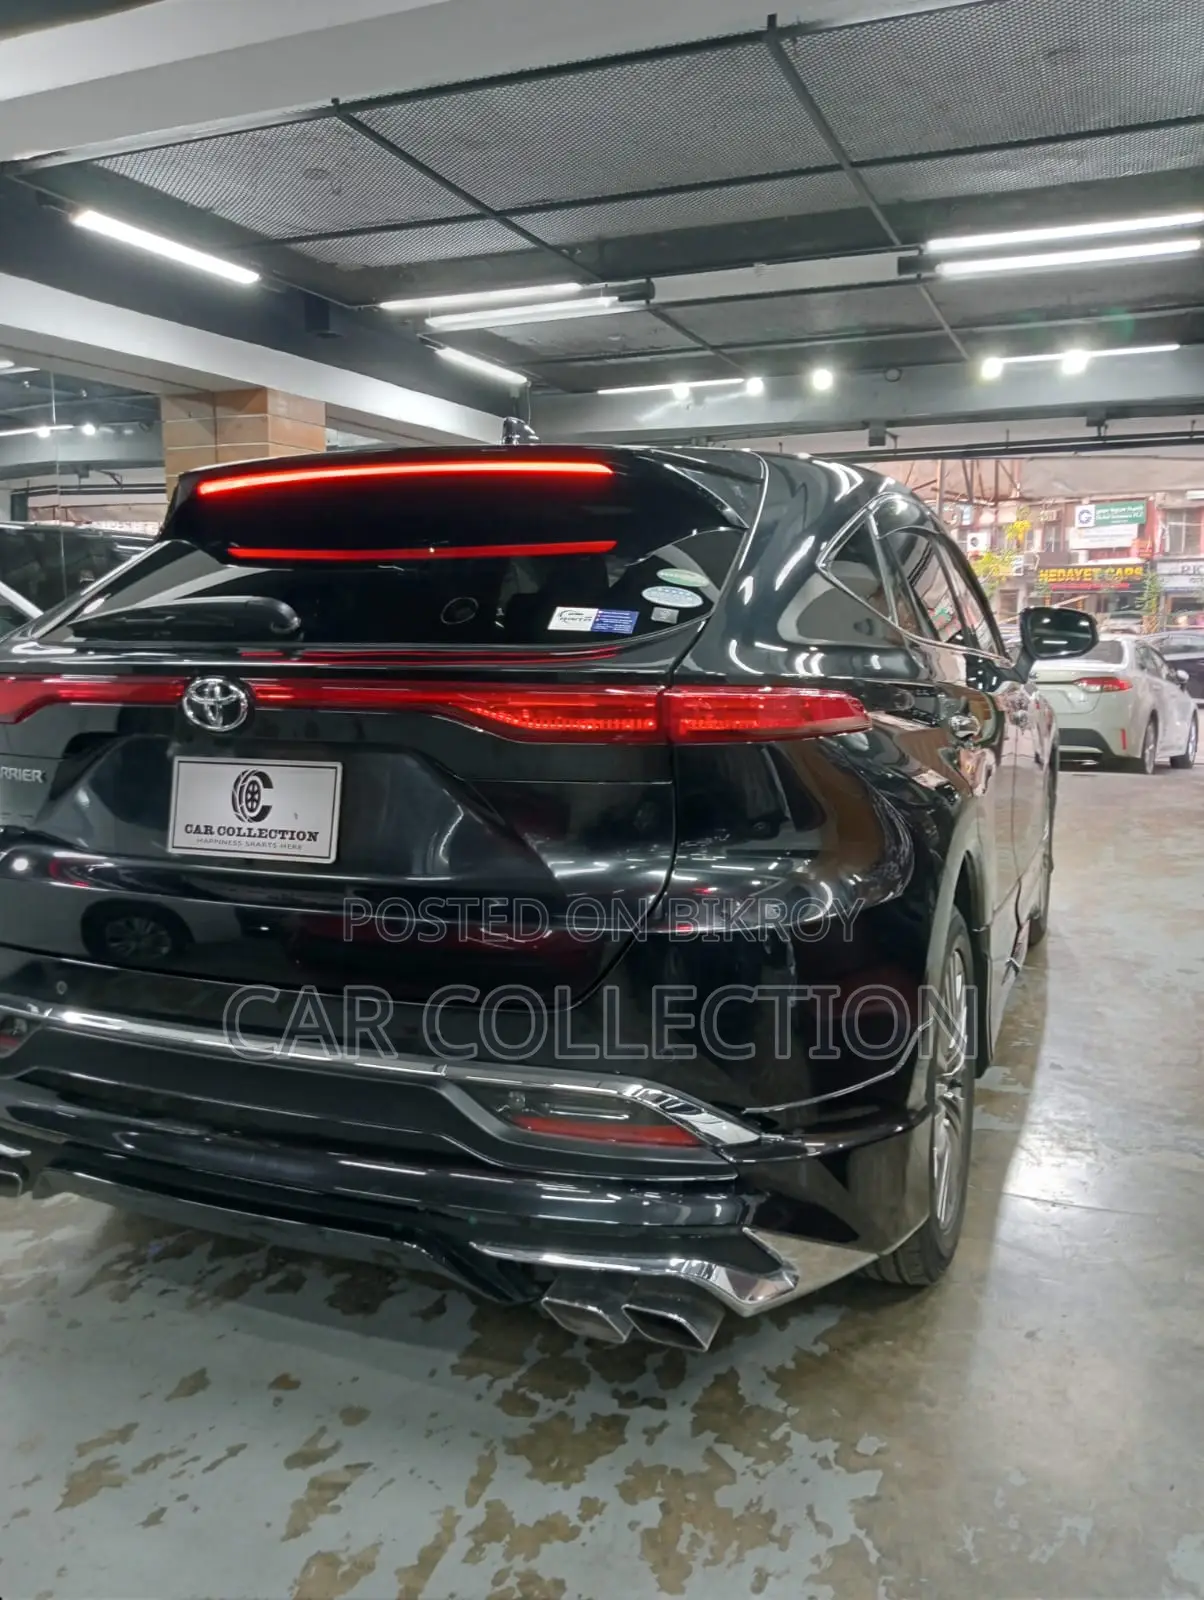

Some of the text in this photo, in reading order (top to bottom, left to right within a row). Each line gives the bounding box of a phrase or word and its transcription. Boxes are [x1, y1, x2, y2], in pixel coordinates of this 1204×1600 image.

[184, 824, 320, 842] CAR COLLECTION
[196, 838, 242, 847] HAPPINESS
